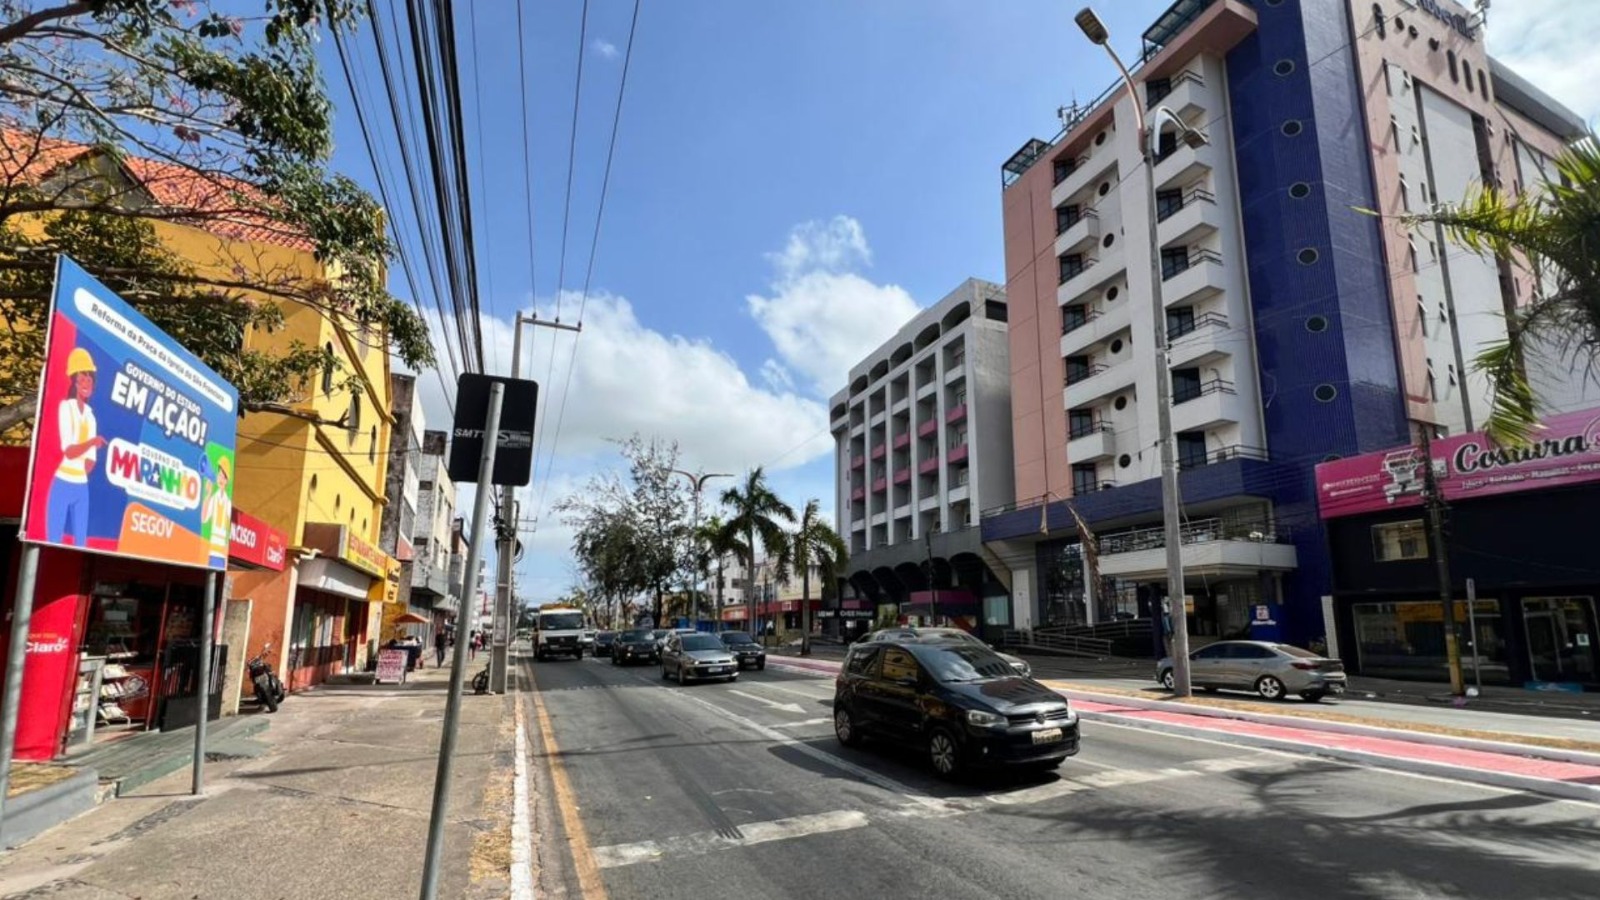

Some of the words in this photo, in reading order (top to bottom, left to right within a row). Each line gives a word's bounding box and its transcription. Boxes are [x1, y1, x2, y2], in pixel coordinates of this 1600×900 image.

[91, 303, 126, 334] Reforma
[127, 328, 137, 341] da
[158, 350, 167, 363] da
[111, 371, 148, 415] EM
[126, 362, 165, 393] GOVERNO
[165, 386, 176, 400] DO
[176, 394, 201, 416] ESTADO
[141, 447, 170, 465] GOVERNO
[130, 511, 175, 539] SEGOV
